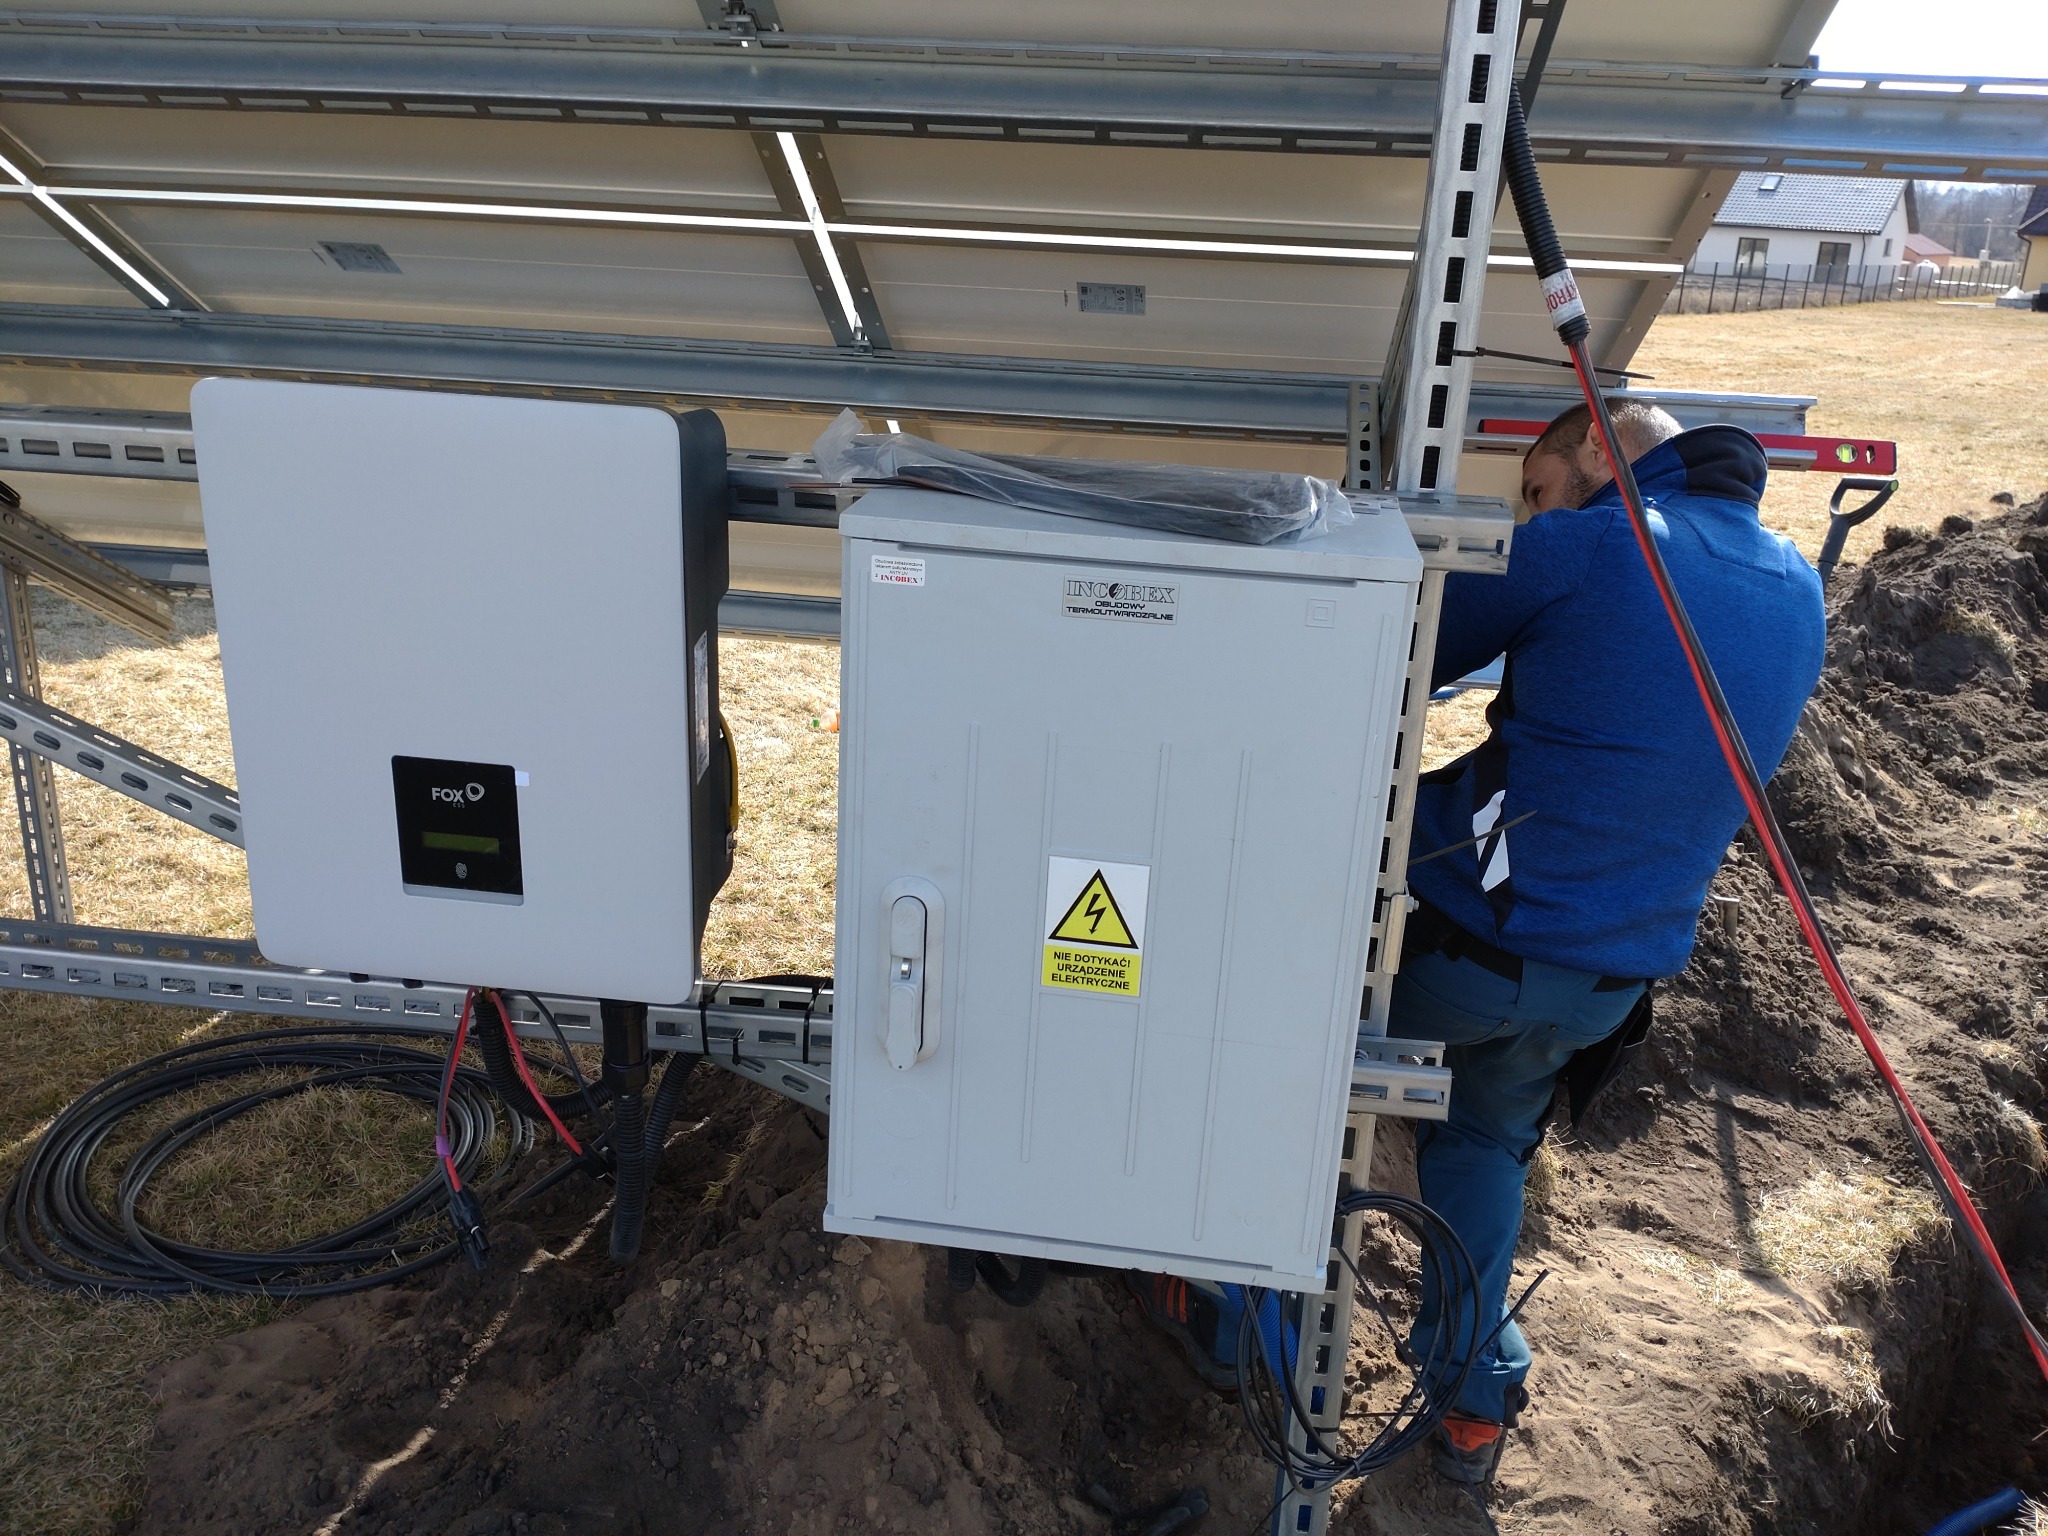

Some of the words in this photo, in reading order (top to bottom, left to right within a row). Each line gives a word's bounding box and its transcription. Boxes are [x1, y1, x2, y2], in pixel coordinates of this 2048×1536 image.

[880, 574, 918, 584] INCOBEX
[1066, 579, 1175, 604] INCOBEX
[1095, 600, 1146, 610] OBUDOWY
[1066, 606, 1174, 621] TERMOUTWARDZALNE
[431, 787, 465, 803] FOX
[1053, 951, 1072, 961] NIE
[1074, 953, 1131, 968] DOTYKAĆ!
[1057, 963, 1126, 979] URZĄDZENIE
[1051, 973, 1130, 990] ELEKTRYCZNE
